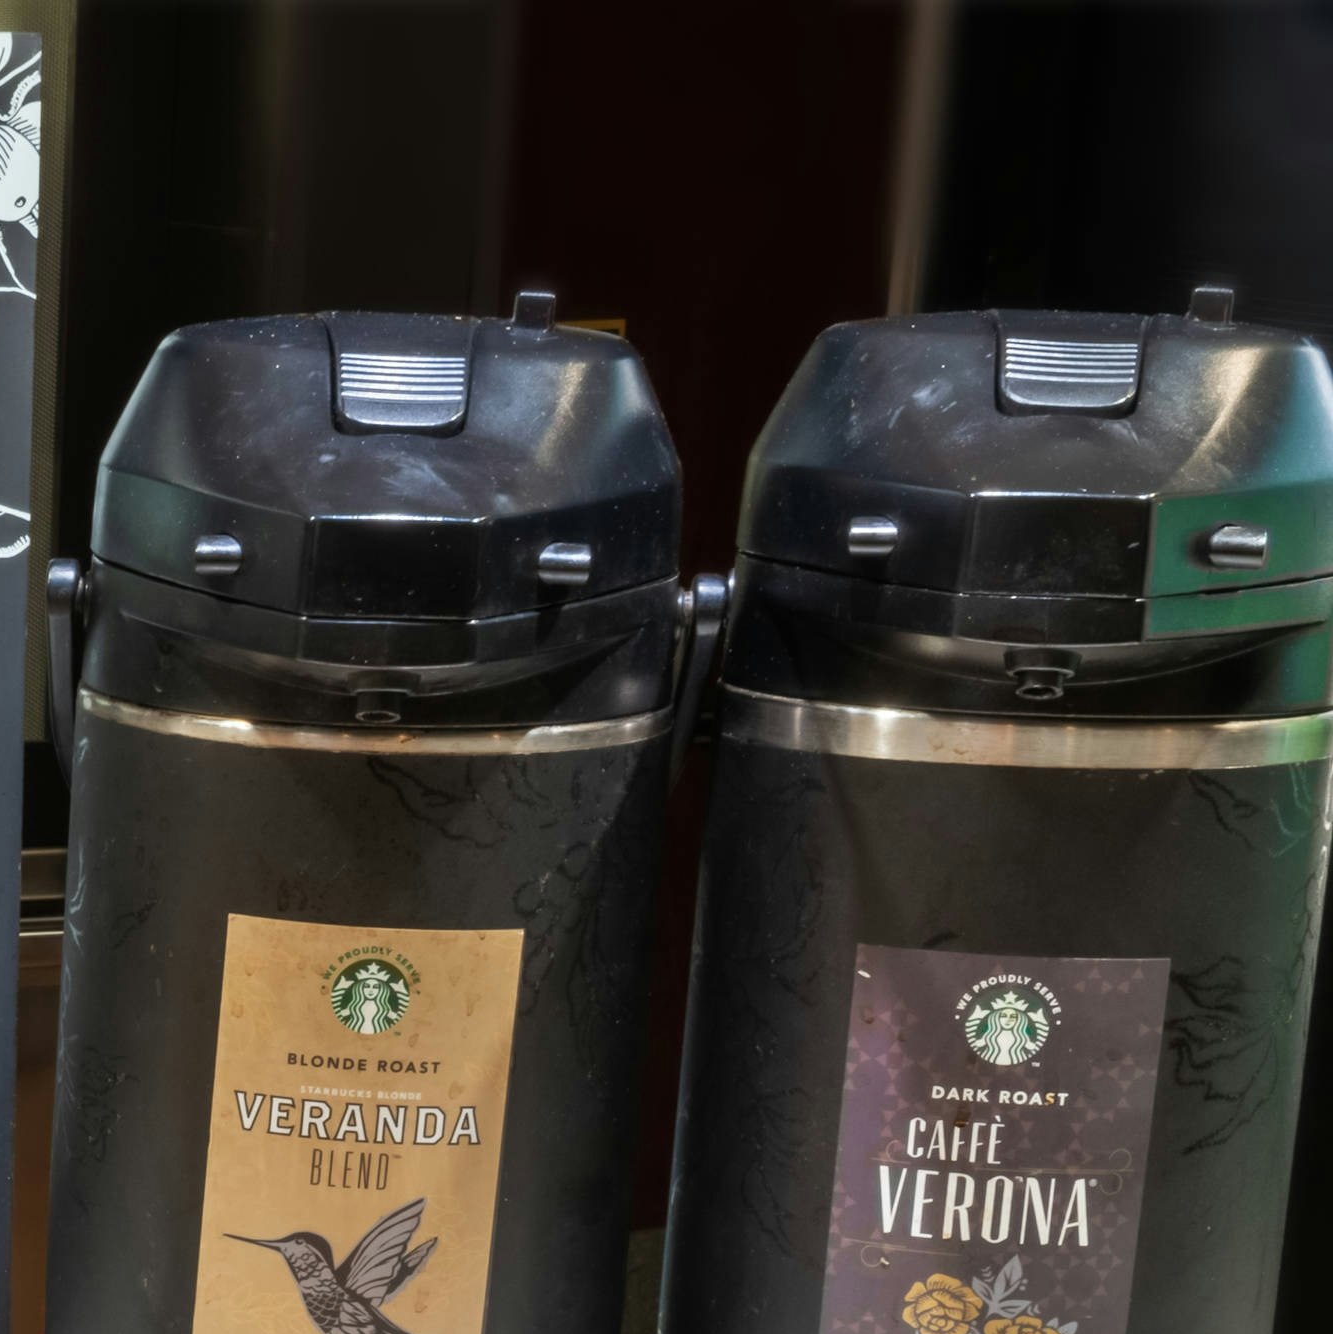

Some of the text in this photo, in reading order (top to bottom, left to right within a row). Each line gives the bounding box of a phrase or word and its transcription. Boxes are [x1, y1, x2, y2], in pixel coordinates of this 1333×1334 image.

[338, 946, 393, 964] PROUDLY
[956, 974, 1062, 1015] WE PROUDLY SERVE
[287, 1052, 441, 1074] BLONDE ROAST
[300, 1085, 422, 1100] STARBUCKS BLONDE
[931, 1085, 1070, 1107] DARK ROAST
[234, 1089, 482, 1146] VERANDA
[906, 1114, 1006, 1165] CAFFÈ
[309, 1148, 390, 1191] BLEND
[878, 1165, 1090, 1247] VERONA
